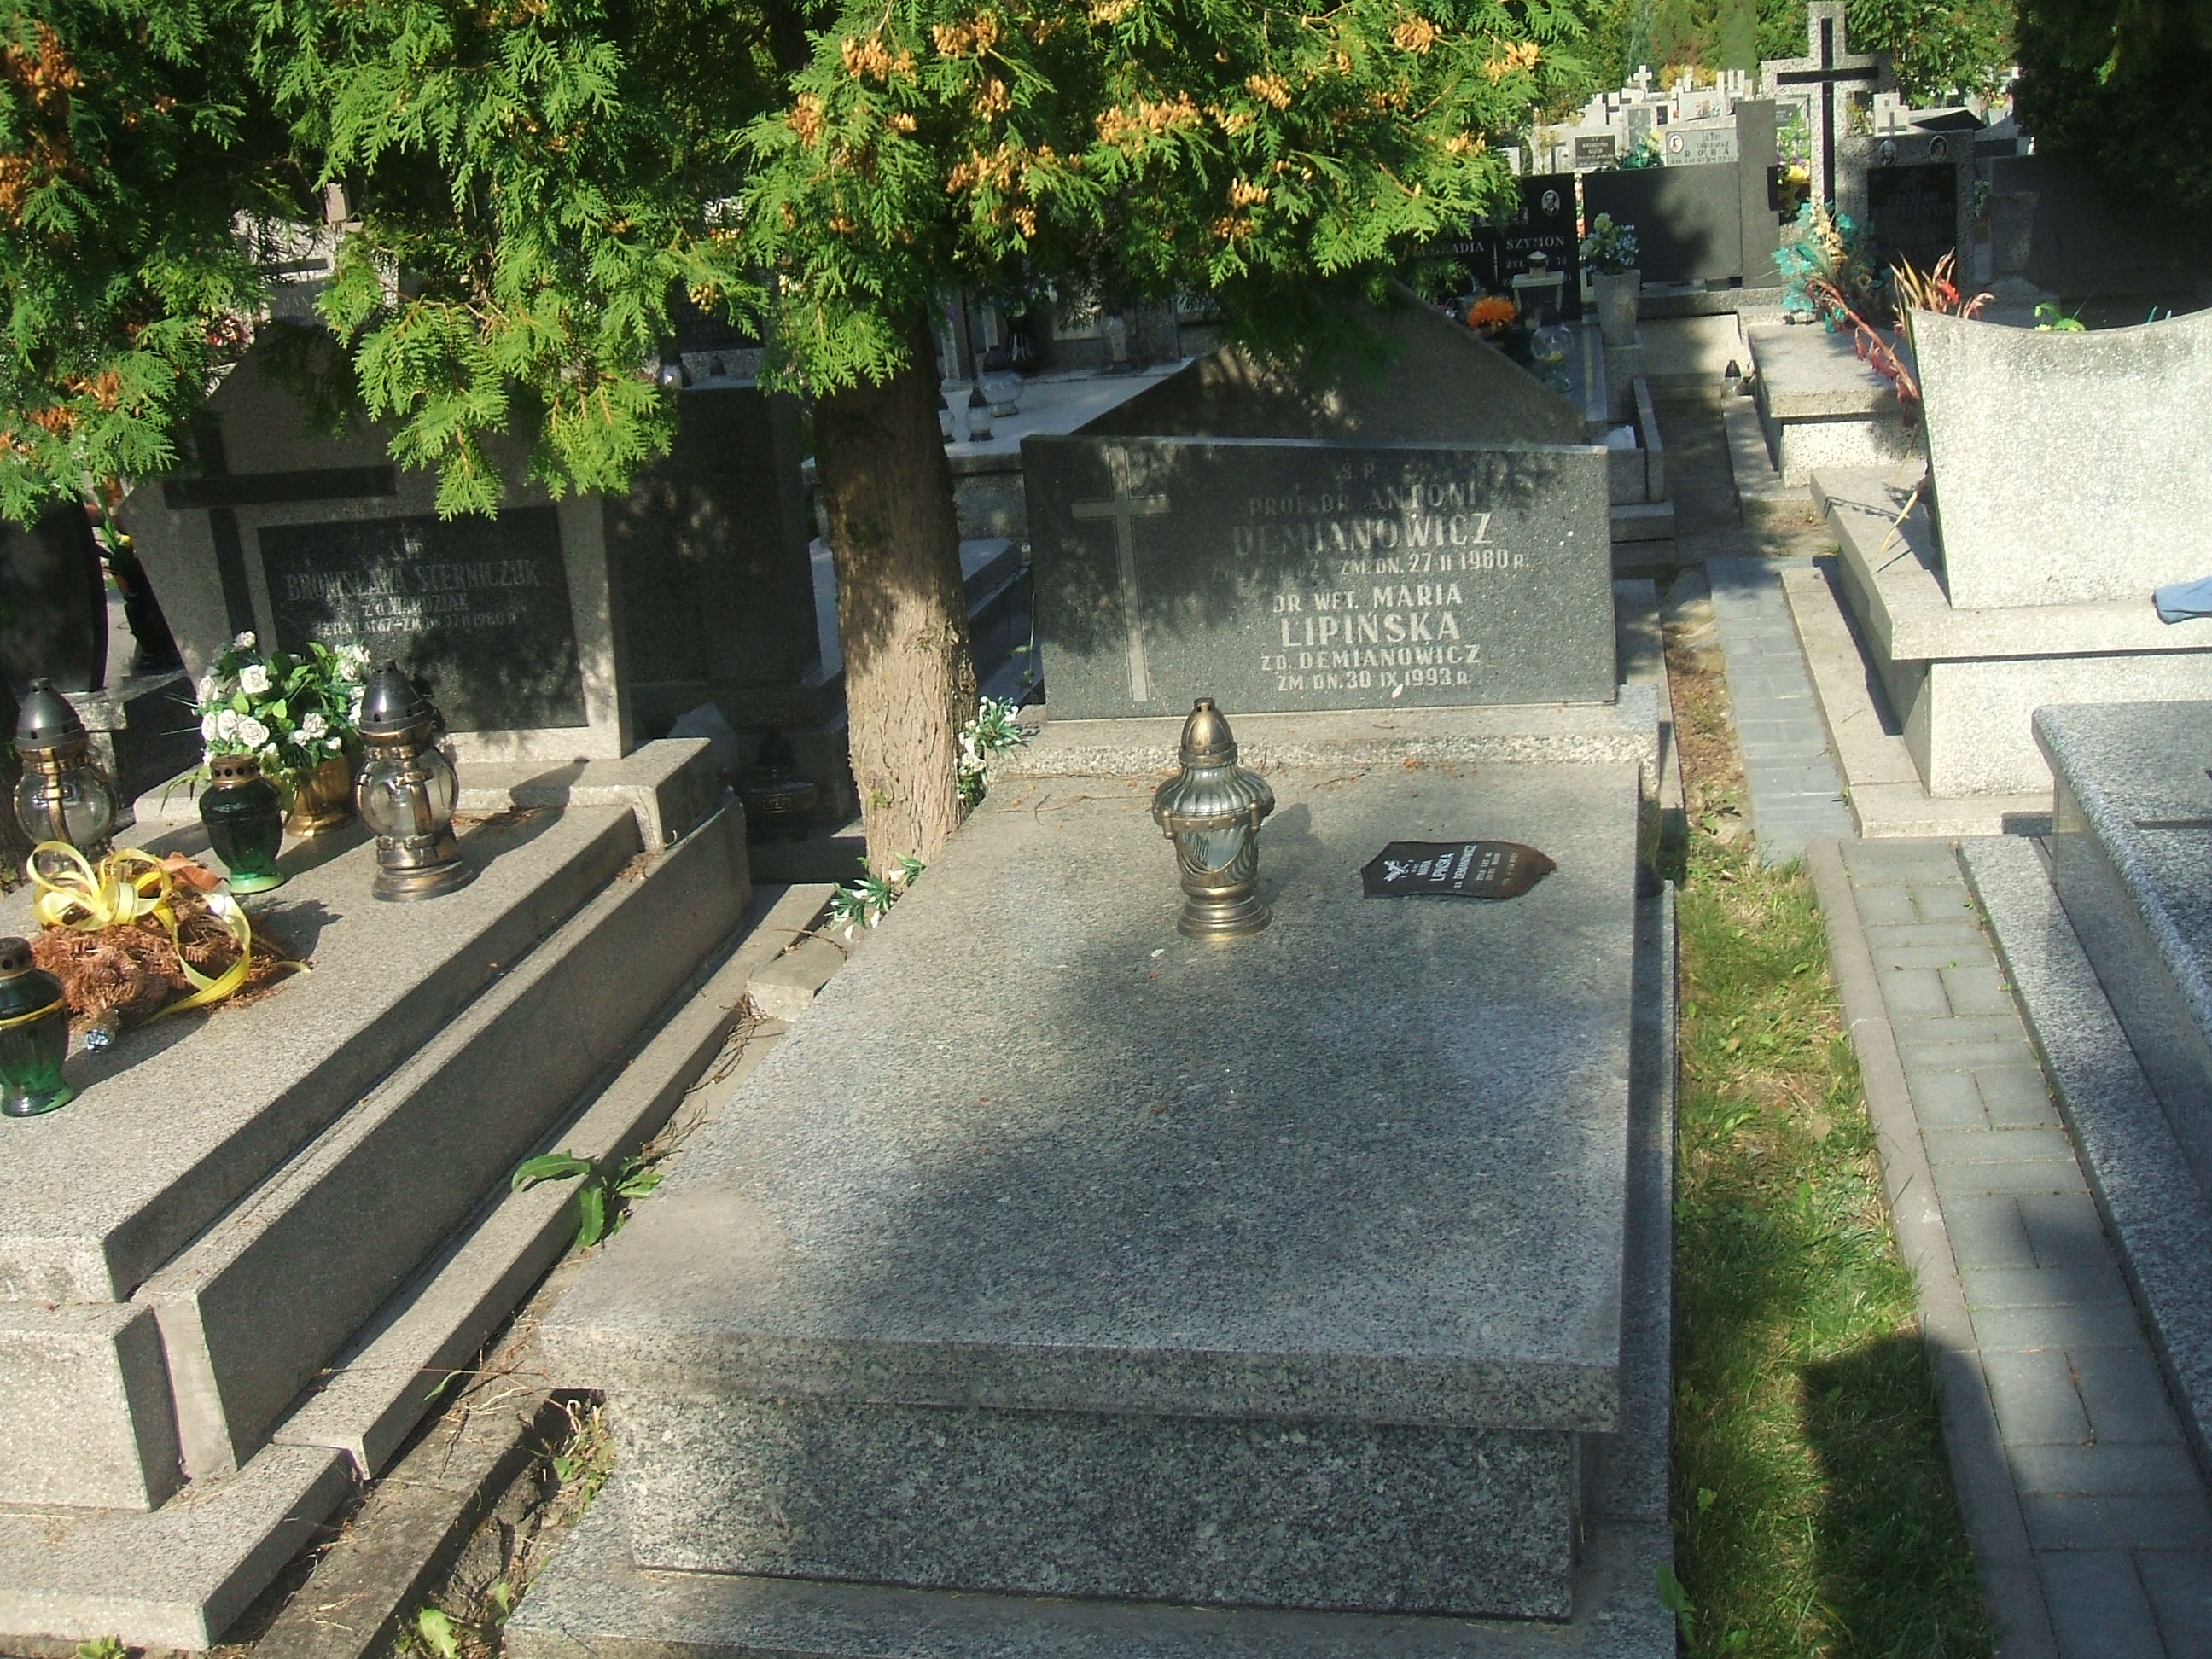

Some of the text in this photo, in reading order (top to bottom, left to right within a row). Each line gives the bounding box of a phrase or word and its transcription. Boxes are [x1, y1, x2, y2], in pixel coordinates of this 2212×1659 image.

[1371, 480, 1476, 510] ANTONI
[1233, 512, 1493, 557] DEMIANOWICZ
[1409, 552, 1432, 573] 27
[1461, 549, 1509, 570] 1980
[1273, 595, 1301, 613] DR
[1374, 583, 1464, 608] MARIA
[1282, 609, 1462, 647] LIPIŃSKA
[1300, 644, 1481, 669] DEMIANOWICZ
[1346, 670, 1371, 689] 30
